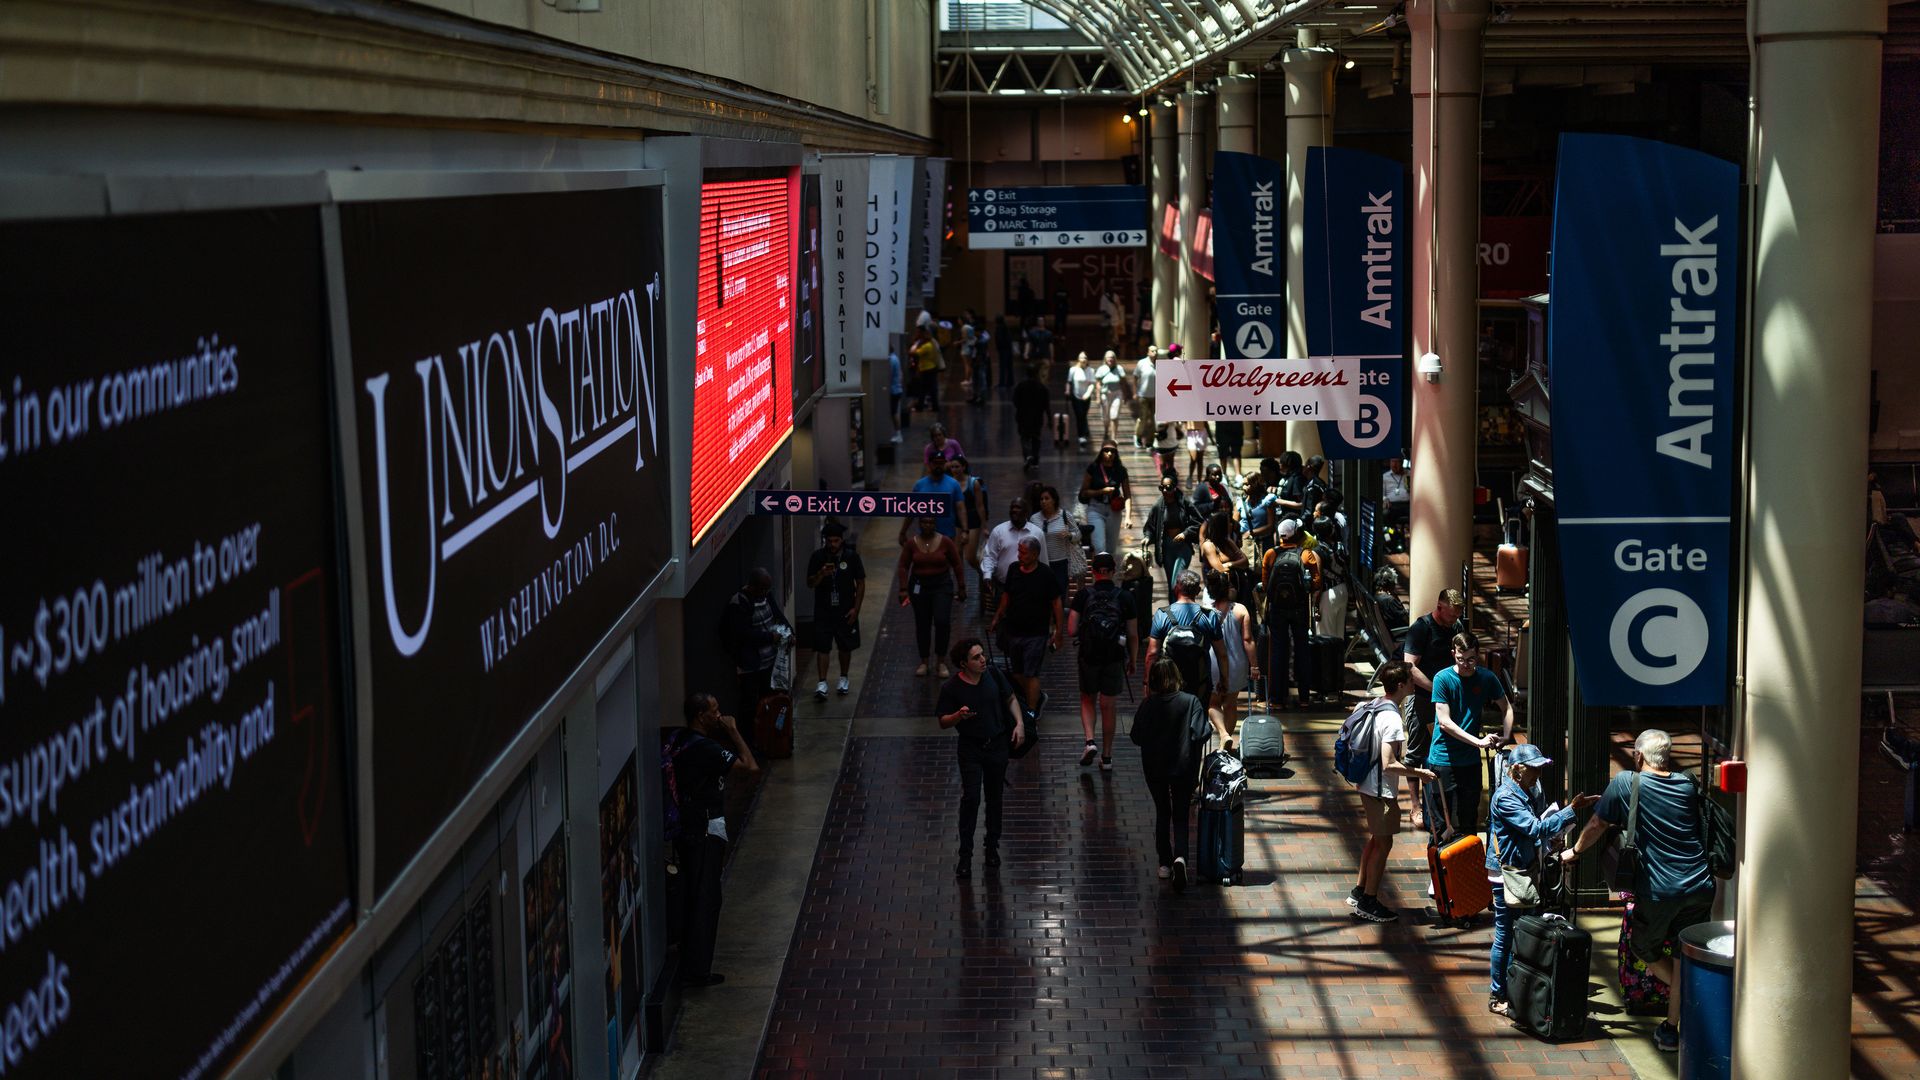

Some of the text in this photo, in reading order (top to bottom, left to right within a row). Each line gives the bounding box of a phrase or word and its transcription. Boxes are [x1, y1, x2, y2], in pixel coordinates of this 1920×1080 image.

[997, 191, 1016, 200] Exit
[998, 204, 1057, 216] Bag Storage
[998, 219, 1058, 229] MARC Trains
[1250, 179, 1273, 276] Amtrak
[836, 179, 847, 383] UNION STATION
[1360, 189, 1393, 329] Amtrak
[1236, 302, 1273, 316] Gate
[1243, 325, 1268, 350] A
[1656, 213, 1719, 470] Amtrak
[13, 372, 42, 456] in
[47, 376, 96, 446] our
[98, 331, 239, 431] communities
[1199, 361, 1349, 396] Walgreens
[1360, 369, 1391, 386] ate
[1206, 401, 1319, 415] Lower Level
[1354, 403, 1380, 439] B
[807, 495, 841, 512] Exit
[882, 496, 945, 515] Tickets
[1613, 538, 1708, 573] Gate
[113, 549, 191, 641] million
[194, 538, 217, 599] to
[219, 520, 261, 584] over
[479, 531, 594, 674] WASHINGTON
[1626, 604, 1679, 667] C
[0, 585, 281, 829] support of housing, small
[0, 679, 275, 950] ealth, sustainability and
[0, 949, 72, 1077] eeds
